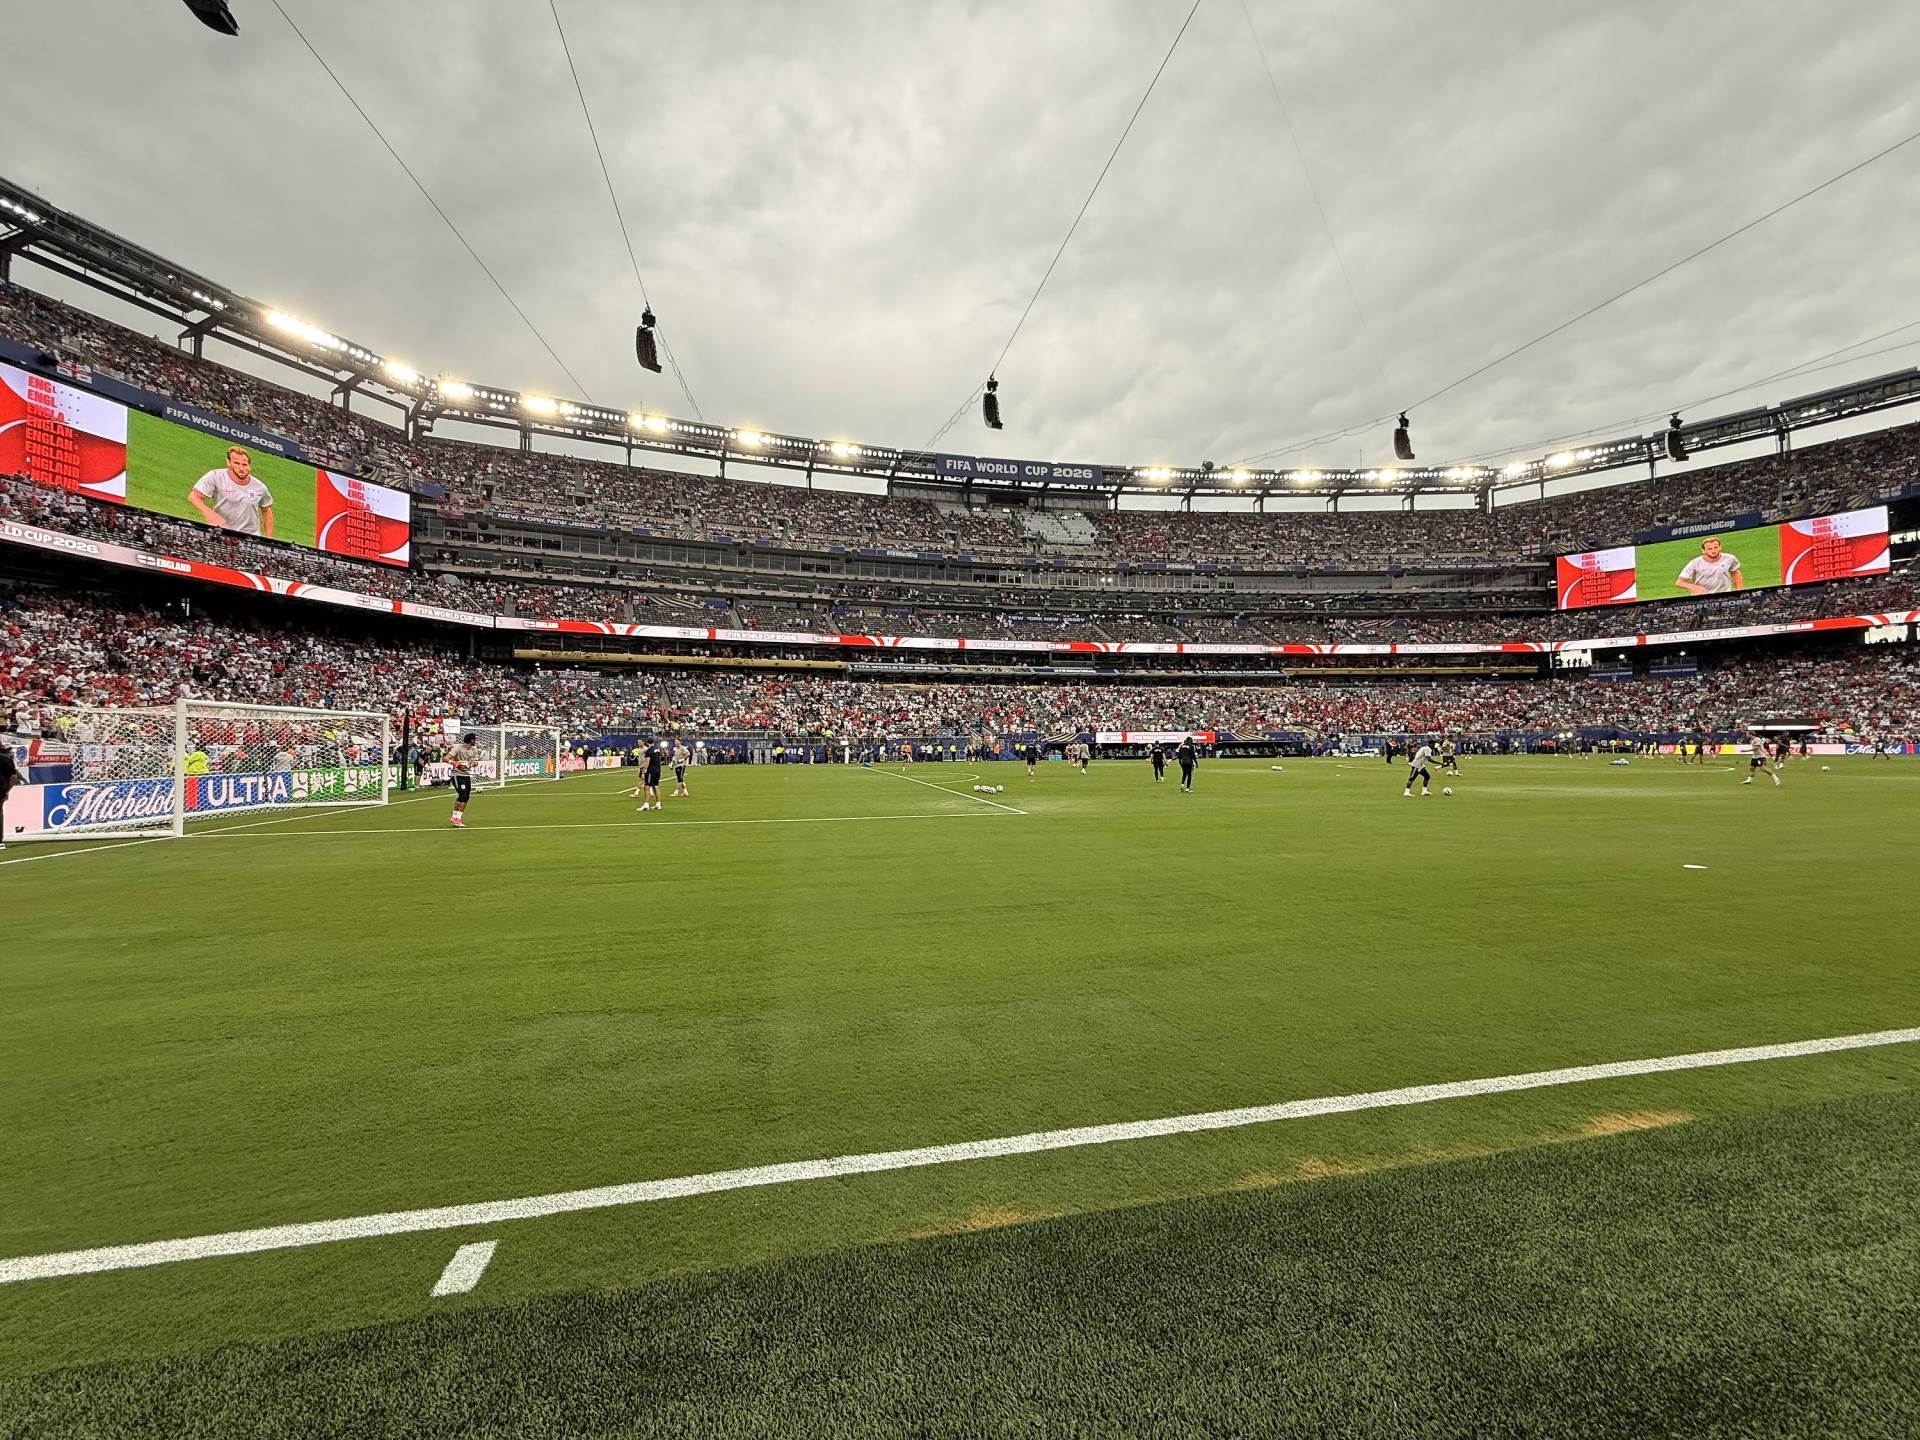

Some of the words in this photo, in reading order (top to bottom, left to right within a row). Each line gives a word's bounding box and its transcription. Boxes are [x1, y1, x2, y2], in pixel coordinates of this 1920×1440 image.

[166, 407, 191, 421] FIFA
[191, 414, 230, 434] WORLD
[230, 428, 251, 441] CUP
[250, 435, 284, 452] 2026
[26, 440, 80, 466] ENGLAND
[945, 459, 972, 471] FIFA
[975, 462, 1019, 475] WORLD
[1024, 465, 1049, 477] CUP
[1052, 467, 1094, 479] 2026
[497, 512, 519, 520] NEW
[520, 515, 546, 524] YORK
[546, 518, 568, 526] NEW
[567, 521, 603, 529] JERSEY
[1671, 519, 1736, 536] #FIFAWorldCup
[24, 530, 52, 543] CUP
[53, 536, 99, 554] 2026
[156, 559, 192, 573] ENGLAND
[417, 607, 433, 616] FIFA
[433, 610, 460, 619] WORLD
[1704, 630, 1720, 638] CUP
[504, 758, 540, 776] Hisense
[48, 784, 175, 829] Michelob
